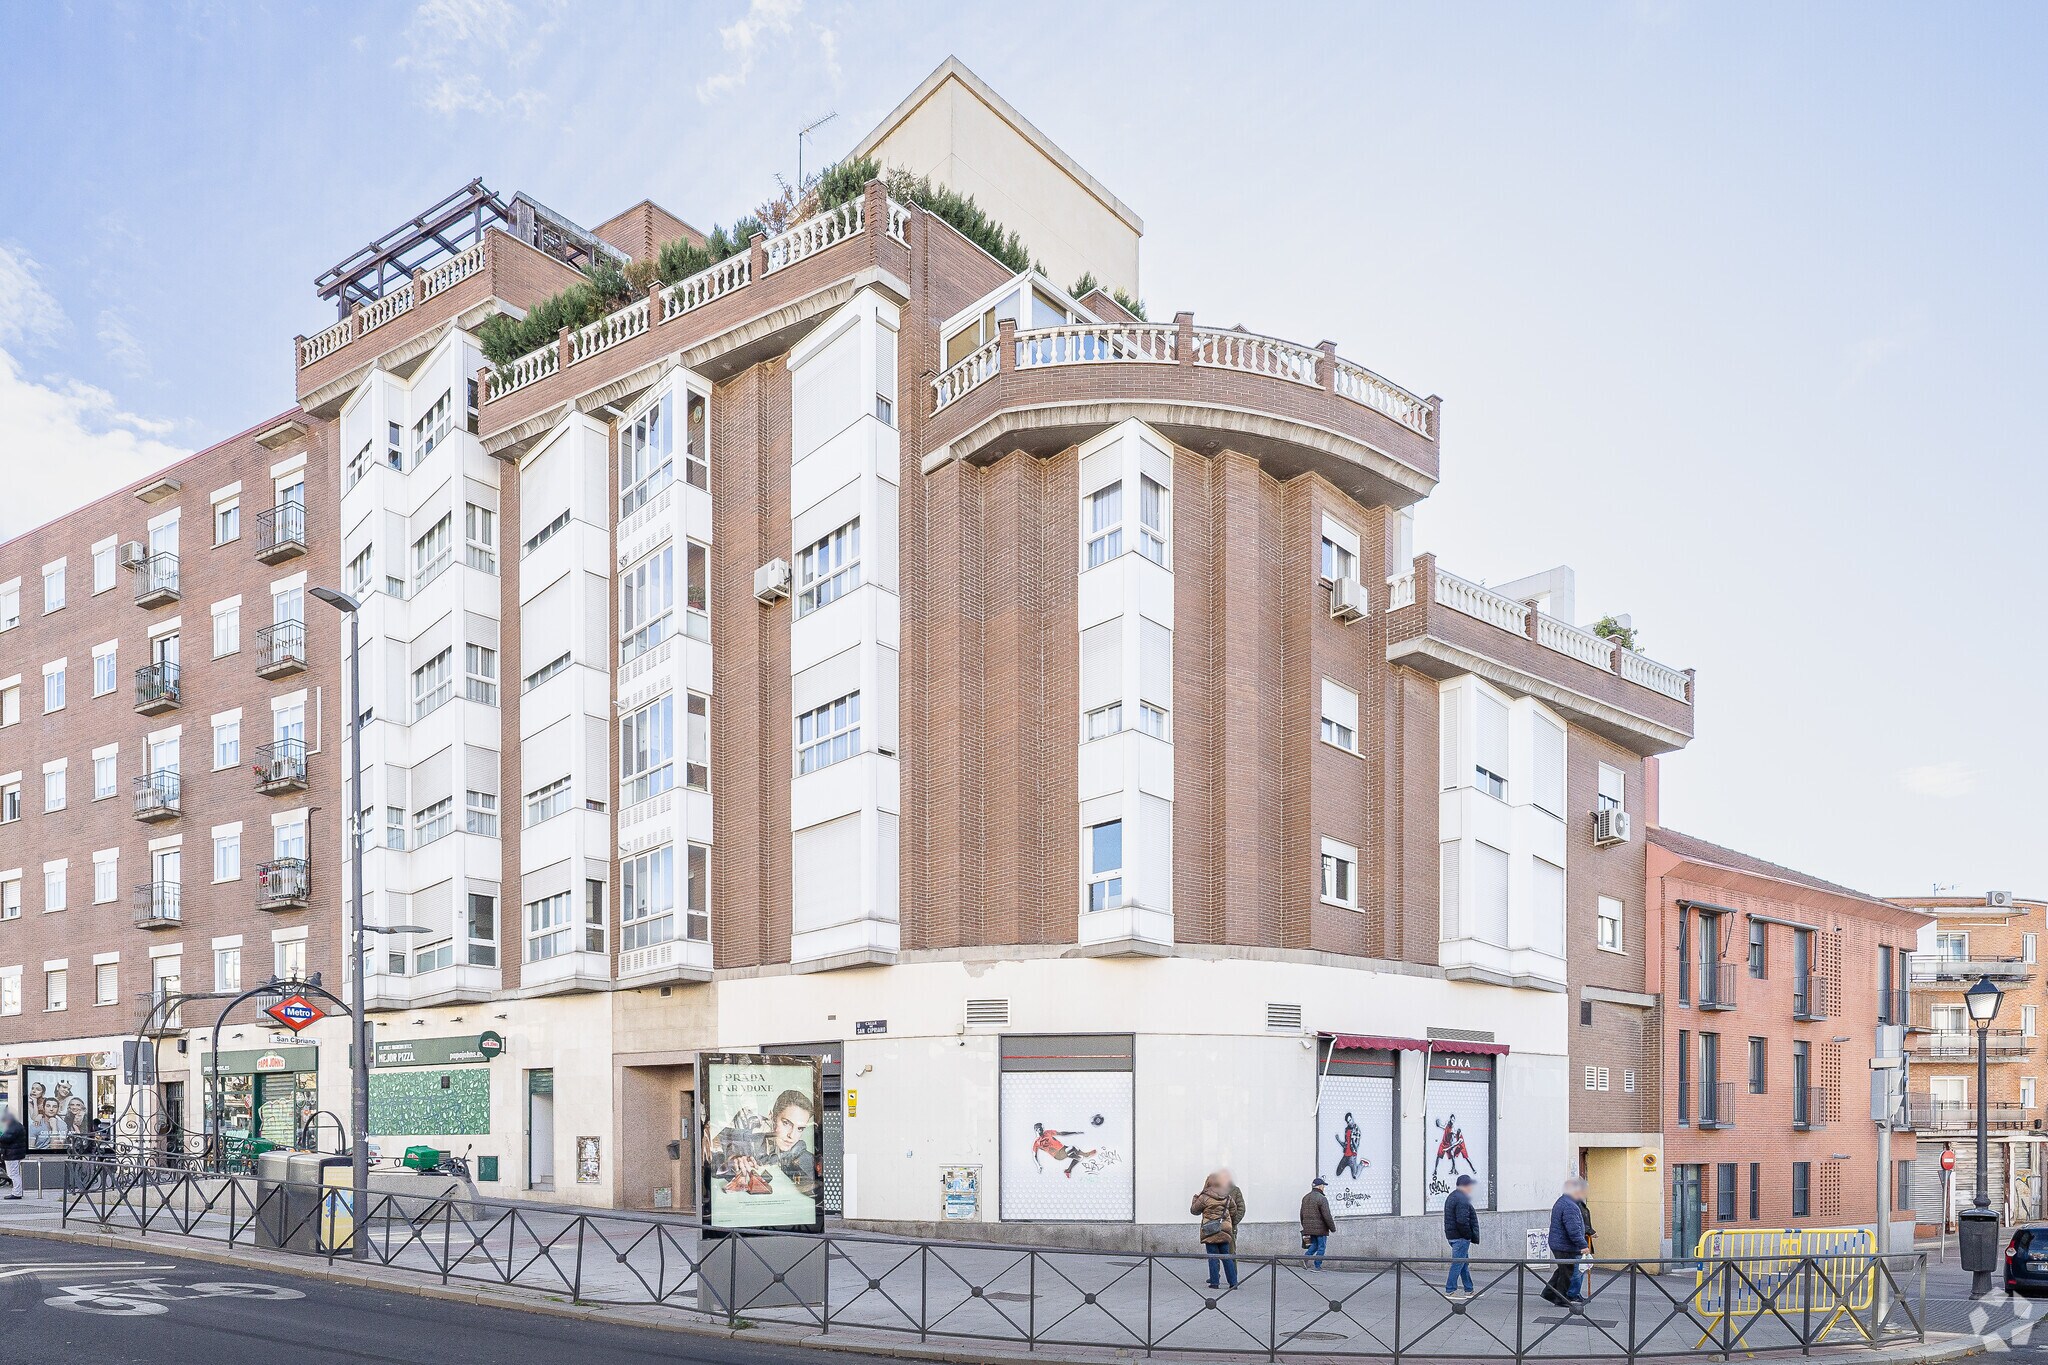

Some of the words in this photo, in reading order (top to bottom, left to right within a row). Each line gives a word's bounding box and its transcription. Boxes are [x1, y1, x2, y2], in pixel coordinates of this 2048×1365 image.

[287, 1008, 310, 1017] Metro
[290, 1037, 316, 1045] Cipriano
[378, 1053, 397, 1062] MEJOR
[257, 1058, 269, 1069] PAPA
[1445, 1058, 1470, 1067] TOKA
[725, 1073, 765, 1082] PRADA
